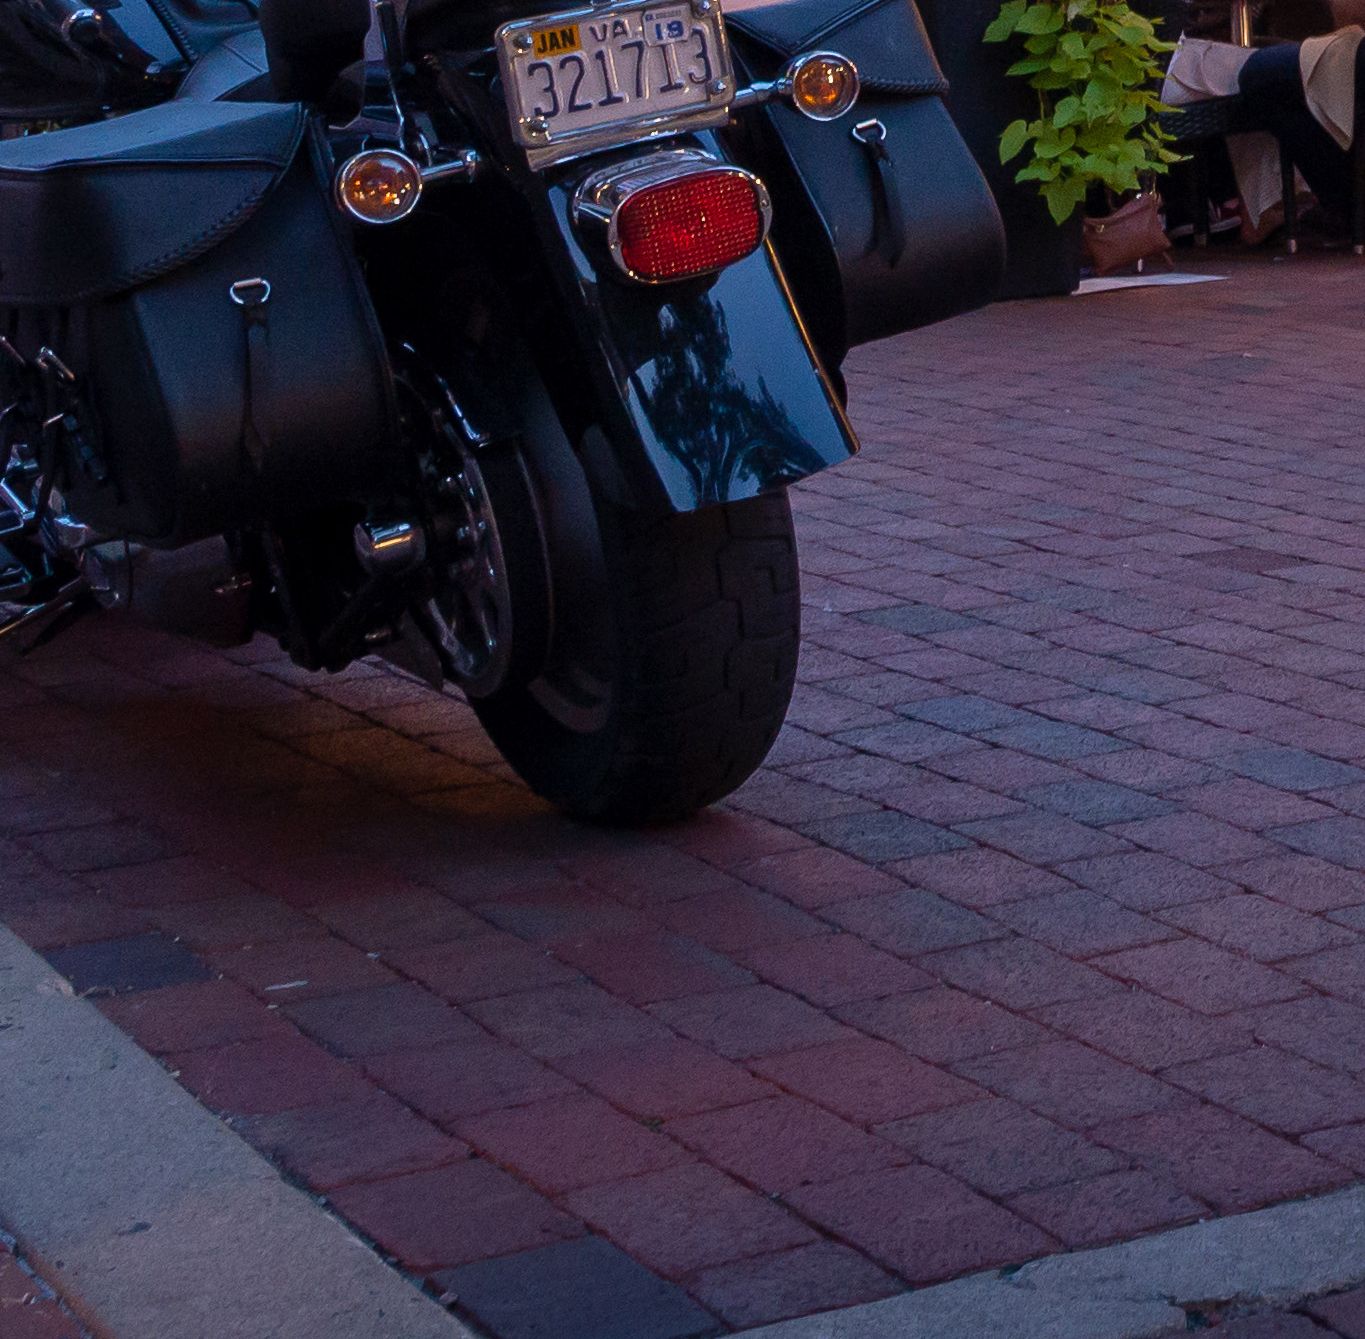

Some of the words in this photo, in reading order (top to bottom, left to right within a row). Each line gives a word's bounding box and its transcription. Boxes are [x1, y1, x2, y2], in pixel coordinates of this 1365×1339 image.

[536, 27, 577, 54] JAN
[655, 19, 685, 40] 19
[527, 25, 713, 119] 321713
